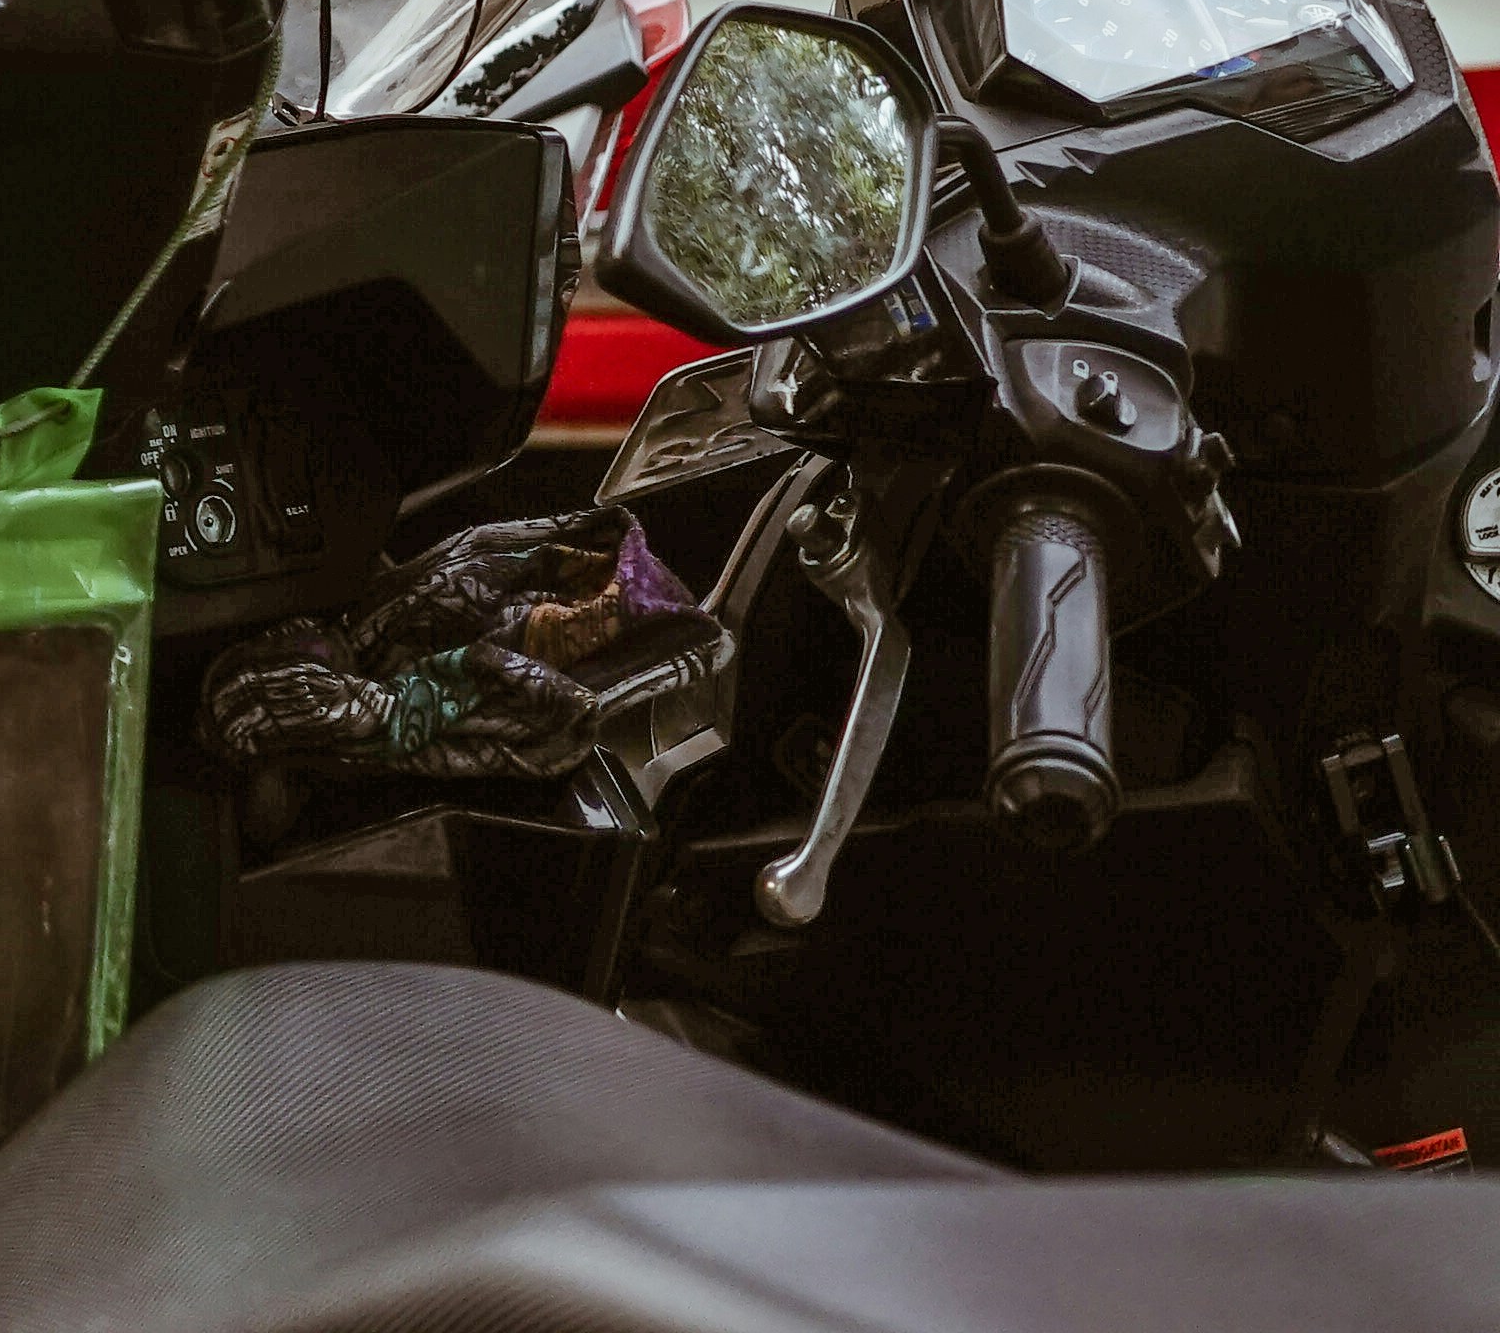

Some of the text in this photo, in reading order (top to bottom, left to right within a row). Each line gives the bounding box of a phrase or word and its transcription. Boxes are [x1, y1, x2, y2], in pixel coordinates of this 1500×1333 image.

[1102, 20, 1119, 38] 40
[1161, 28, 1179, 49] 20
[162, 424, 178, 438] ON
[140, 451, 160, 466] OFF
